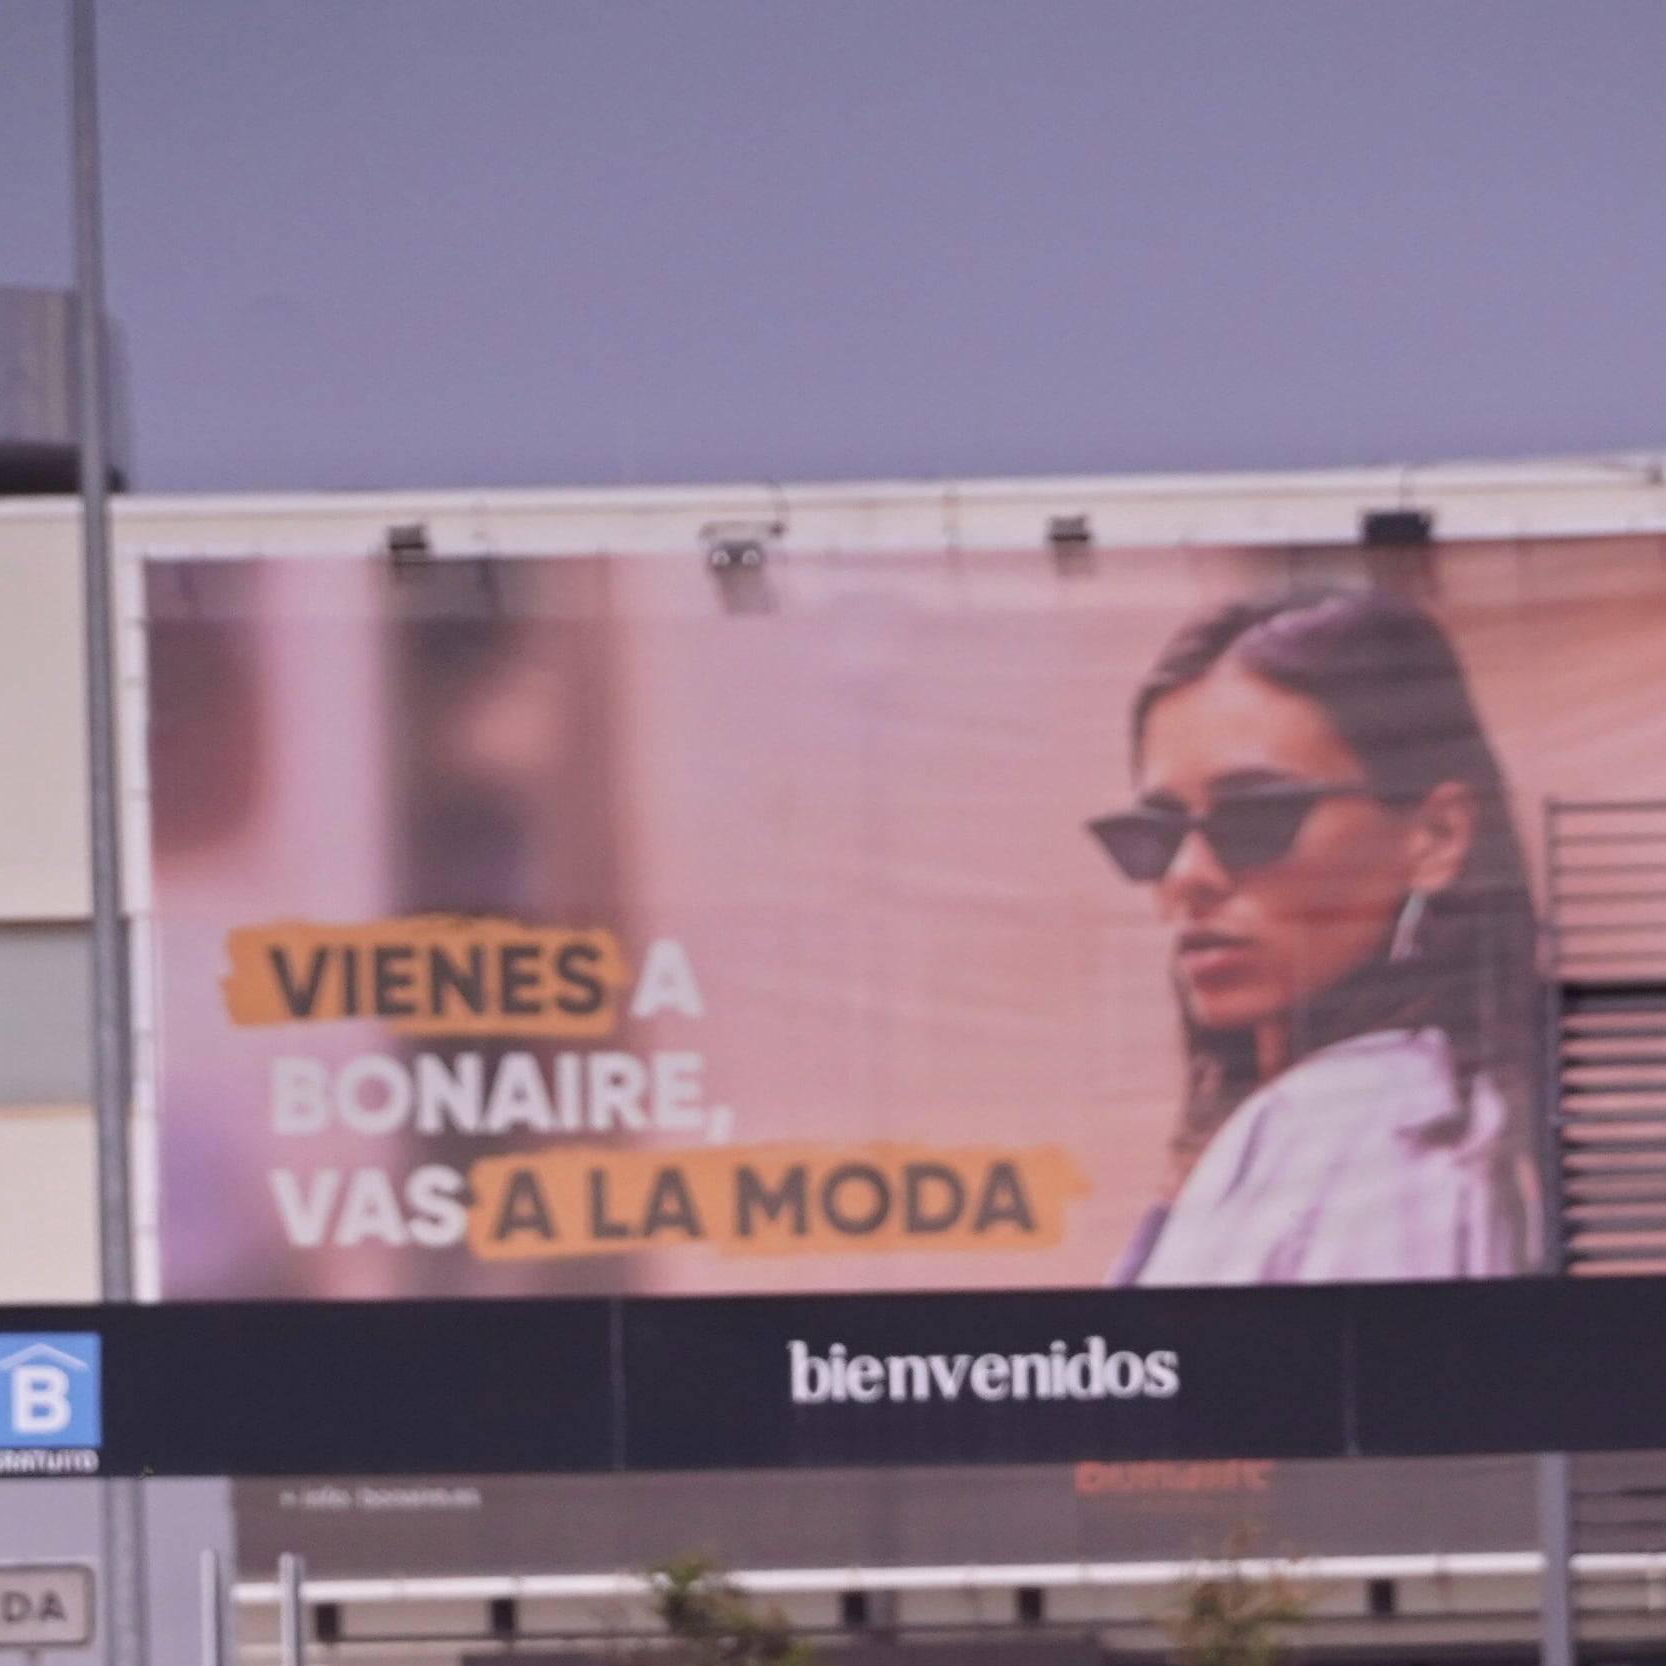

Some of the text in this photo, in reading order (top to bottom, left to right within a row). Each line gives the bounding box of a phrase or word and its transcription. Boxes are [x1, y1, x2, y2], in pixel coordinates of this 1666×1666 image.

[268, 937, 705, 1021] VIENES A
[269, 1049, 731, 1145] BONAIRE,
[267, 1160, 1037, 1250] VAS A LA MODA
[786, 1334, 1181, 1403] bienvenidos
